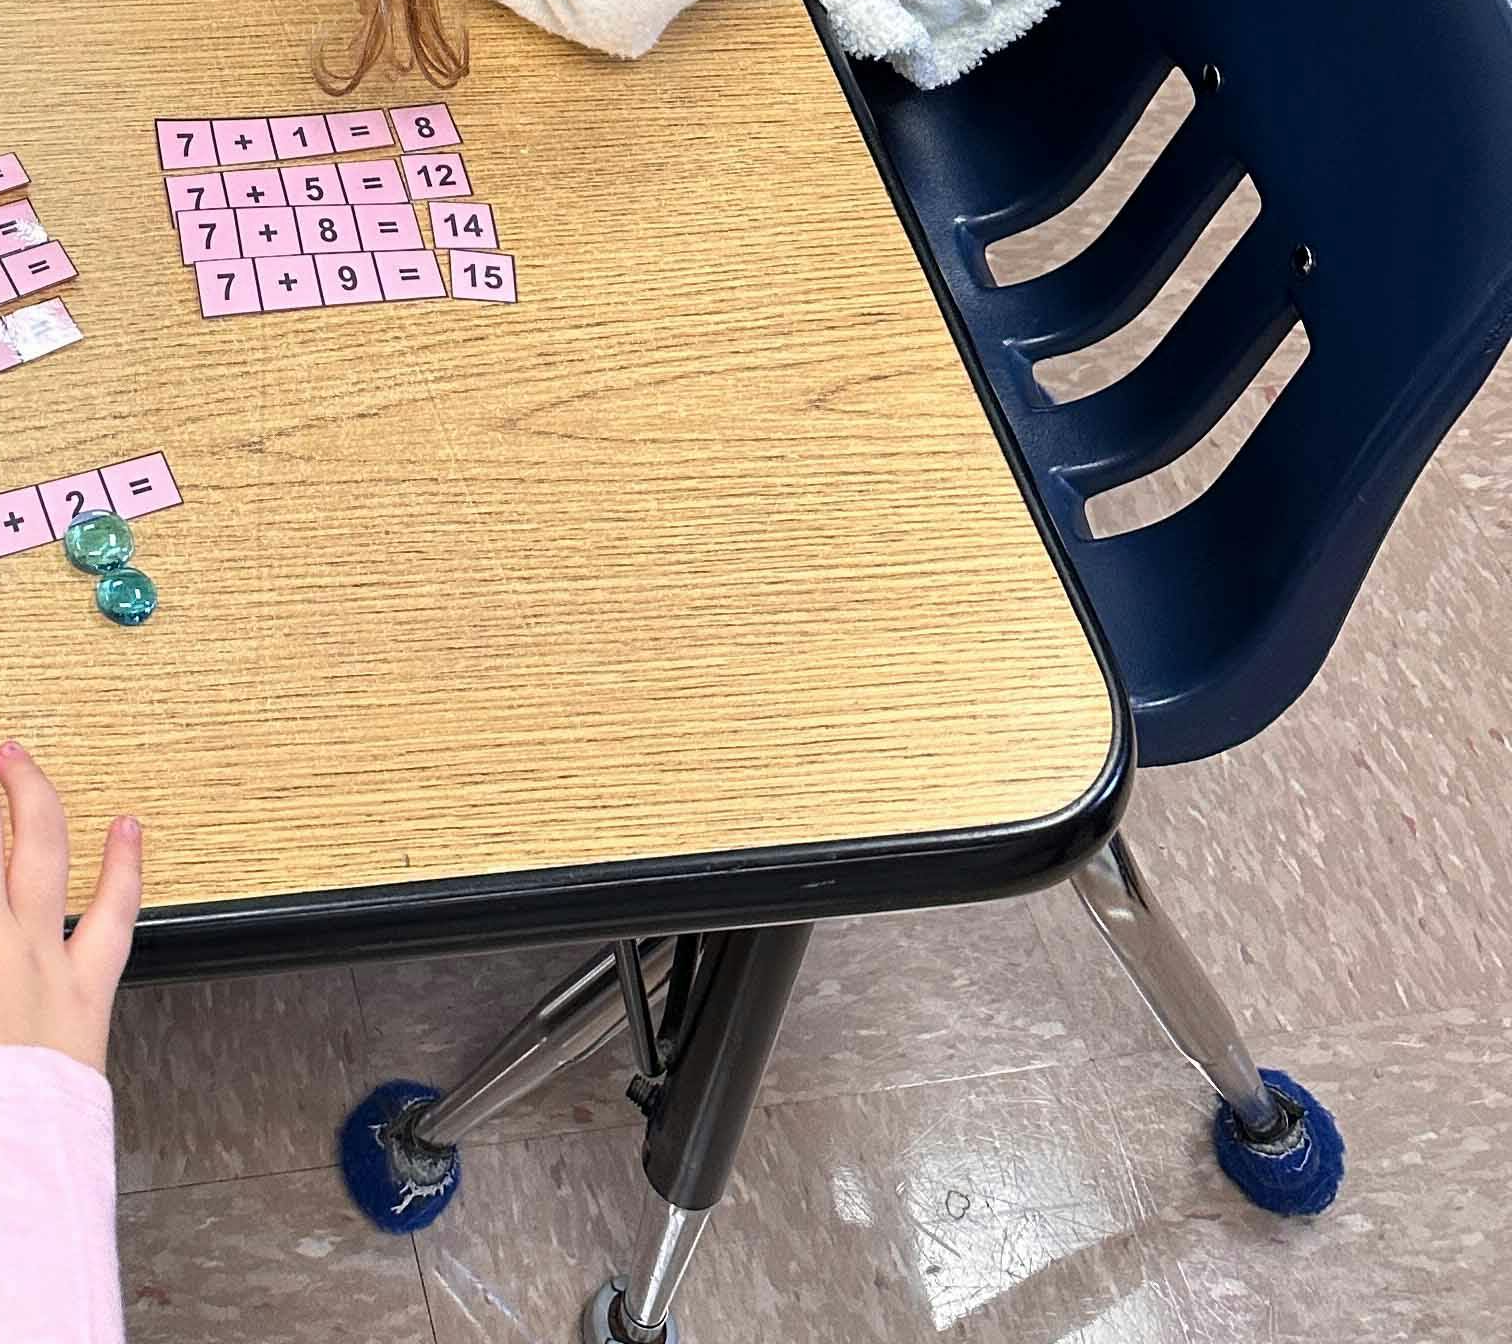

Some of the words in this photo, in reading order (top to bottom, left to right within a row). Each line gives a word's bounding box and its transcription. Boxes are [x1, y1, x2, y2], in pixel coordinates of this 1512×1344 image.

[176, 133, 194, 157] 7
[234, 134, 253, 150] +
[292, 126, 309, 147] 1
[350, 125, 370, 138] =
[414, 117, 435, 138] 8
[187, 187, 205, 210] 7
[246, 186, 265, 204] +
[305, 177, 324, 201] 5
[362, 176, 383, 190] =
[416, 164, 457, 187] 12
[198, 224, 217, 250] 7
[258, 224, 278, 242] +
[319, 218, 338, 242] 8
[378, 221, 399, 233] =
[444, 213, 484, 237] 14
[28, 260, 50, 275] =
[217, 273, 235, 301] 7
[278, 273, 298, 291] +
[338, 266, 358, 291] 9
[399, 267, 421, 281] =
[463, 264, 503, 289] 15
[3, 511, 25, 533] +
[129, 477, 153, 496] =
